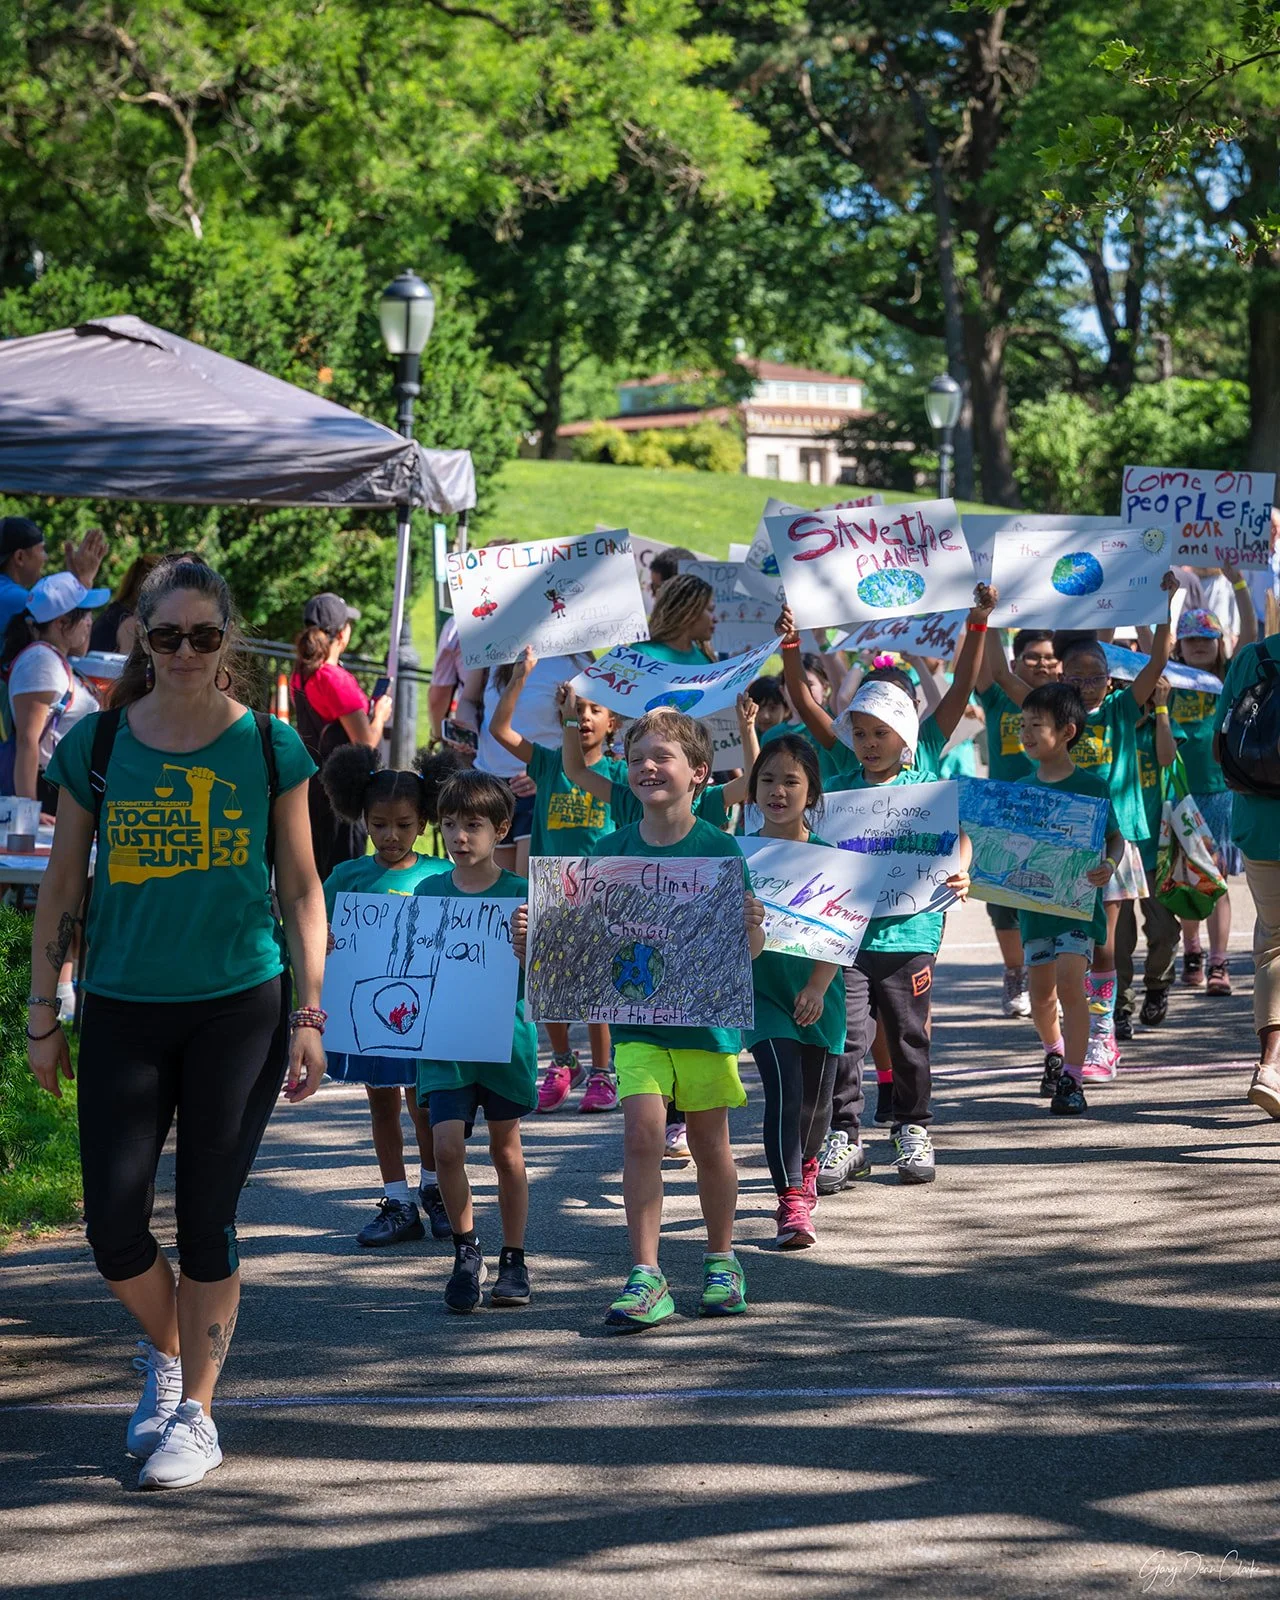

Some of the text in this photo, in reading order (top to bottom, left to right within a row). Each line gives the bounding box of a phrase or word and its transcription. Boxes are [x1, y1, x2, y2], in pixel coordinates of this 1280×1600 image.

[448, 550, 487, 573] STOP
[497, 541, 587, 570] CLIMATE
[1178, 542, 1208, 555] and
[600, 659, 645, 682] LESS
[608, 646, 669, 676] SAVE
[584, 666, 639, 696] CARS
[108, 808, 201, 827] SOCIAL
[110, 829, 203, 848] JUSTICE
[211, 827, 250, 848] PS
[138, 848, 203, 867] RUN
[211, 848, 249, 867] 20
[565, 857, 617, 917] Stop
[340, 894, 390, 929] Stop
[445, 940, 486, 969] coal
[627, 1004, 647, 1025] the
[652, 1006, 688, 1025] Earth
